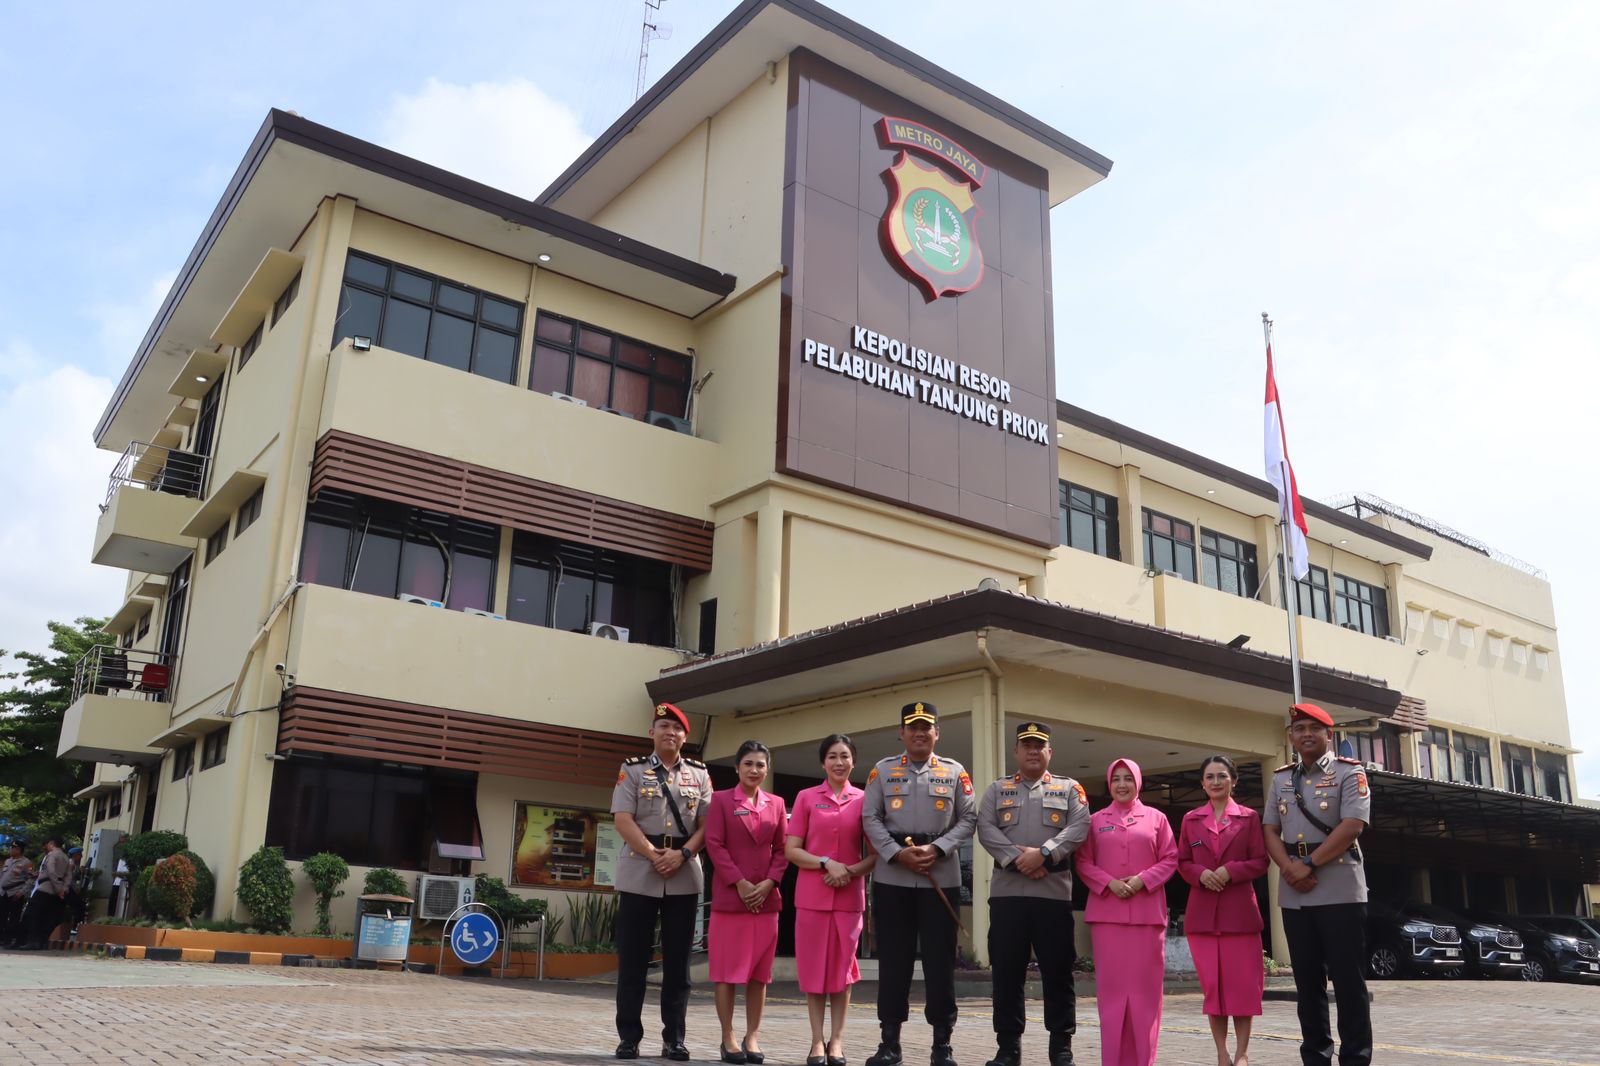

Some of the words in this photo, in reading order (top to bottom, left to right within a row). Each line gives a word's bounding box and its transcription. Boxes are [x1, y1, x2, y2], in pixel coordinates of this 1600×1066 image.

[895, 125, 943, 150] METRO
[946, 147, 977, 176] JAYA
[803, 338, 915, 398] PELABUHAN
[919, 378, 998, 426] TANJUNG
[1002, 408, 1049, 445] PRIOK
[853, 325, 955, 383] KEPOLISIAN
[959, 364, 1012, 403] RESOR
[463, 887, 471, 912] AUX
